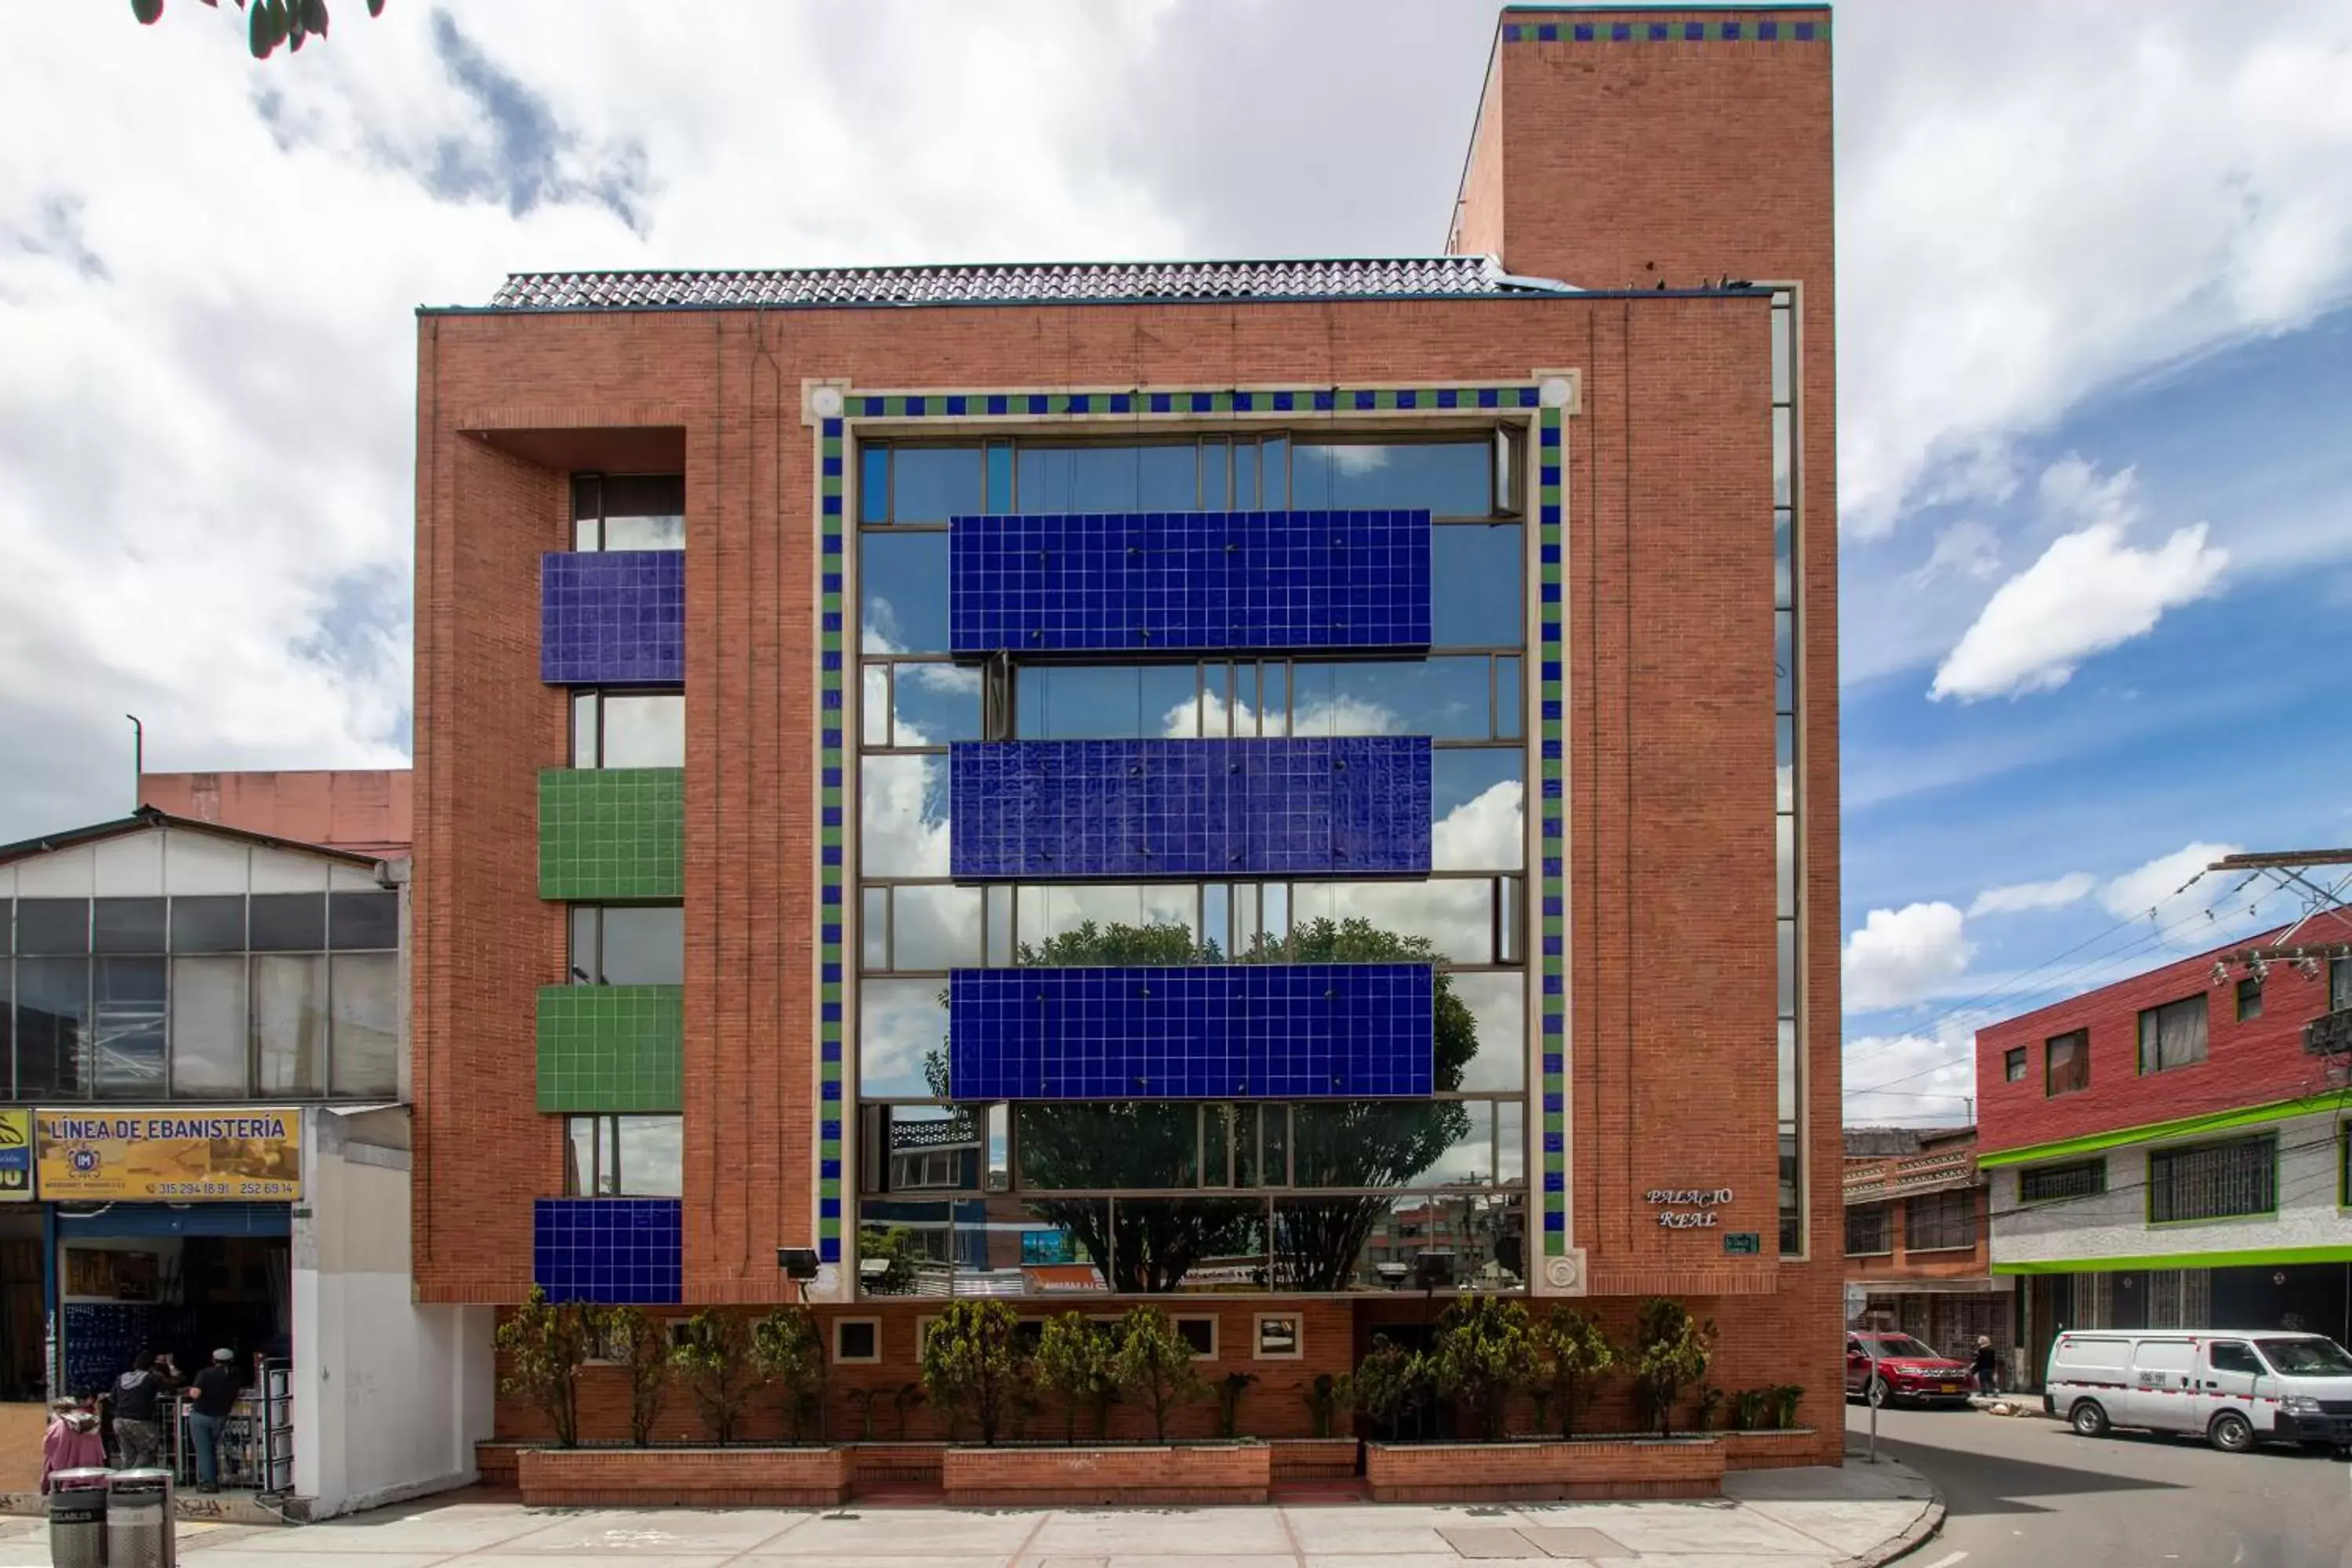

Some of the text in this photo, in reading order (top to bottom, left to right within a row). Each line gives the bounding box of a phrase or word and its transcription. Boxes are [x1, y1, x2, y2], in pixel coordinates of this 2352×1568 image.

[51, 1113, 286, 1139] LÍNEA DE EBANISTERÍA
[159, 1183, 176, 1194] 315
[241, 1182, 261, 1194] 252
[1646, 1187, 1733, 1208] PALACIO
[1658, 1210, 1718, 1229] REAL
